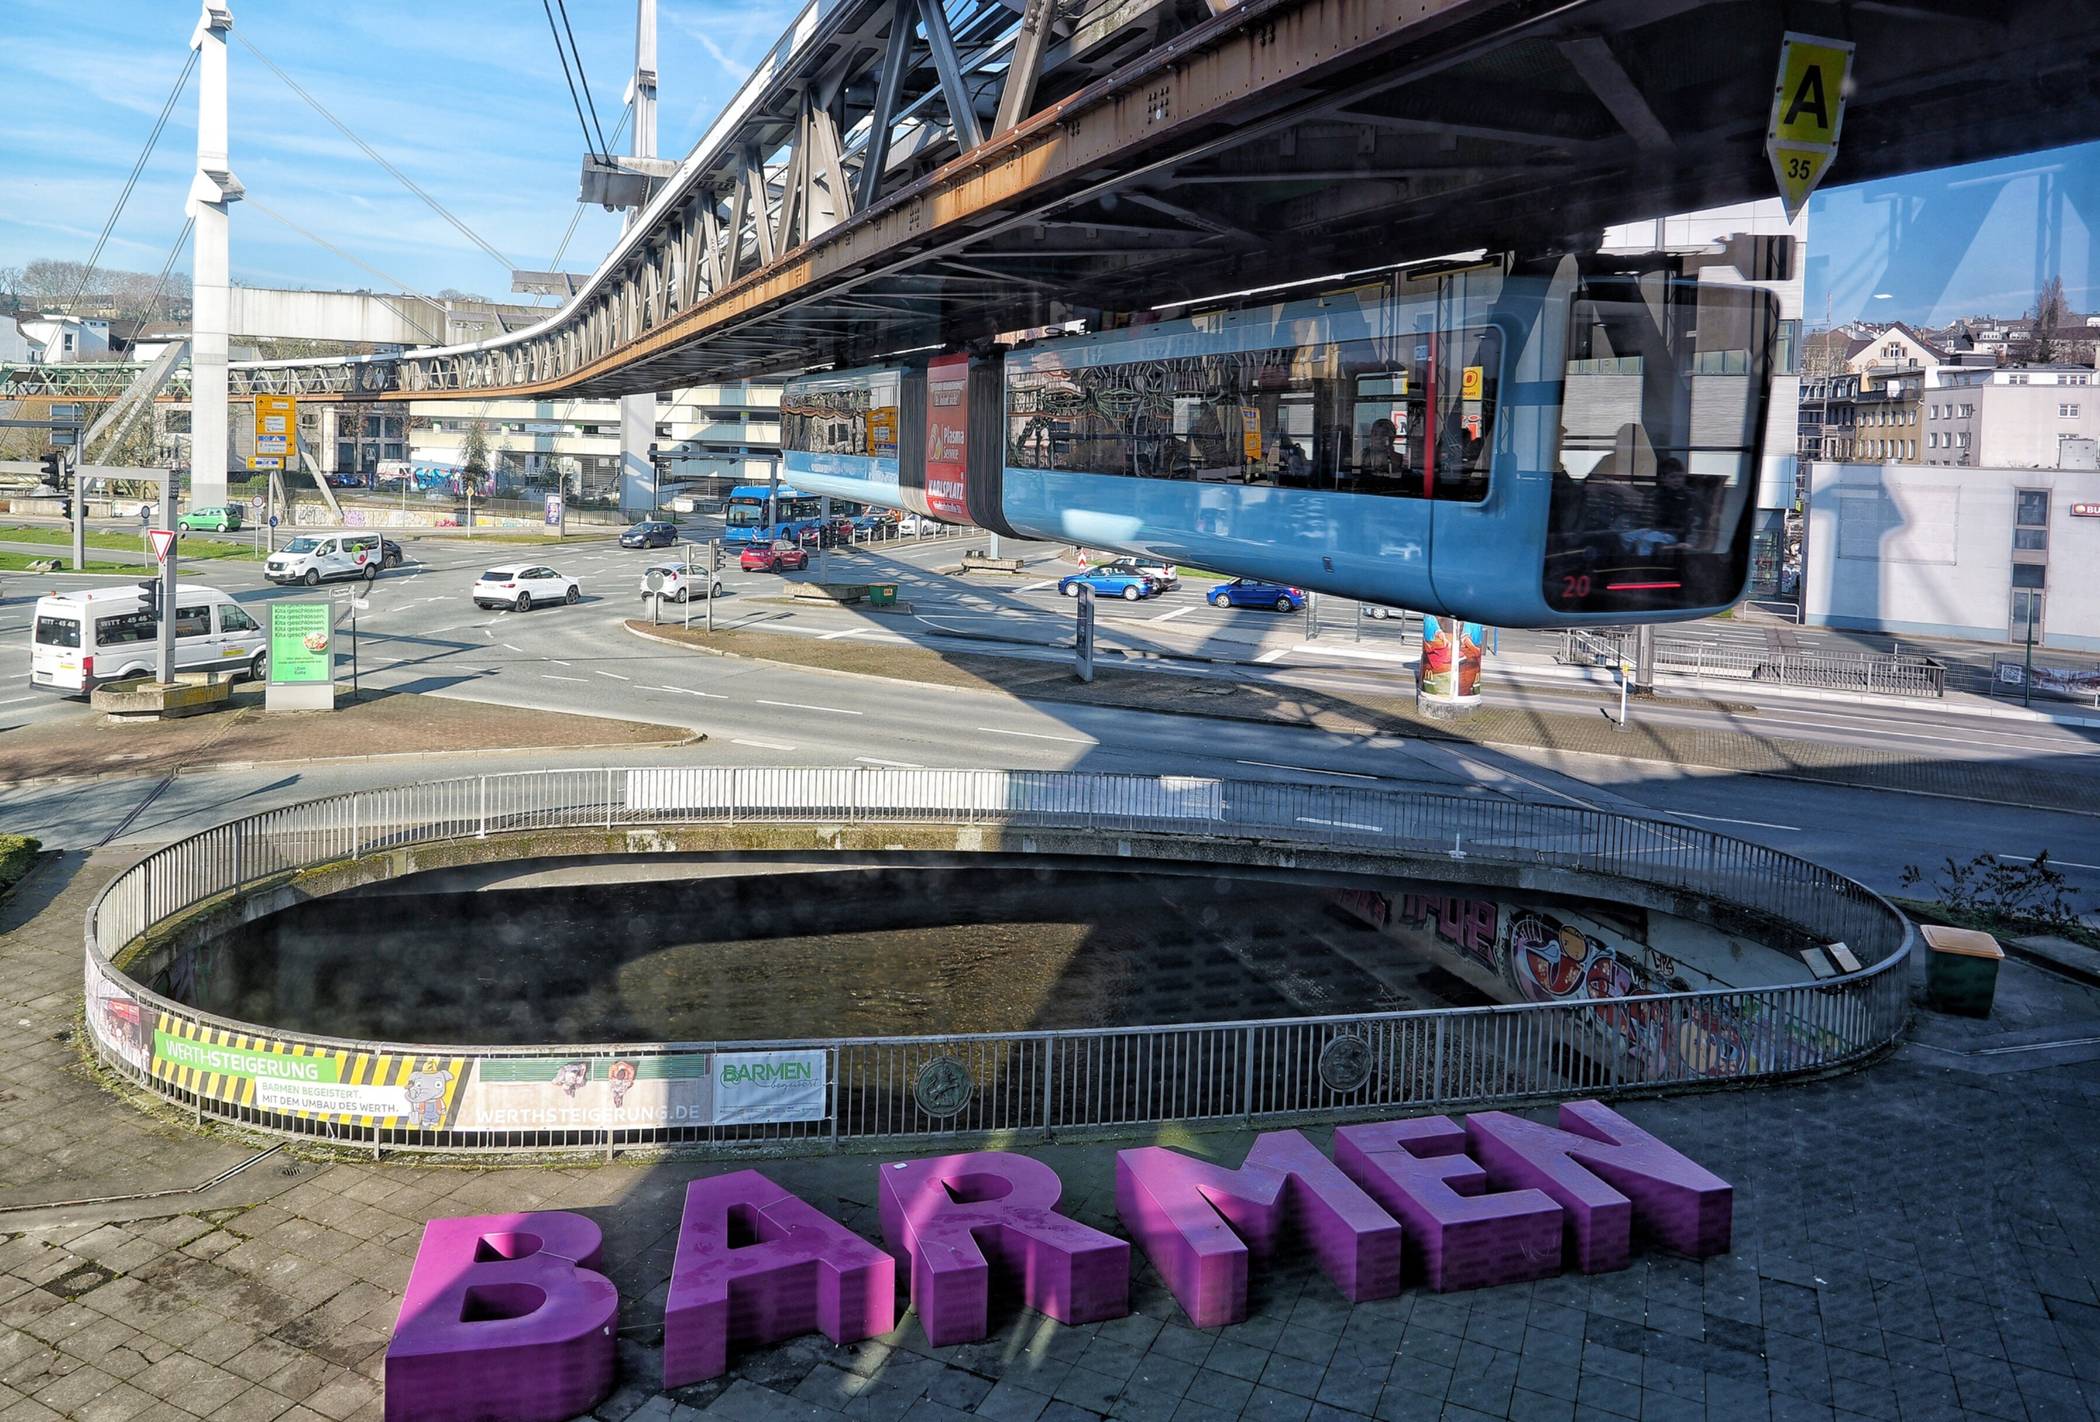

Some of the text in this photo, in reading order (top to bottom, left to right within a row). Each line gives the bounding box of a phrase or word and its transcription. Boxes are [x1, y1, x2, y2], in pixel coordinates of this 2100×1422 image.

[1783, 64, 1828, 129] A
[1787, 158, 1811, 181] 35
[943, 426, 964, 445] Plasma
[928, 480, 964, 500] KARLSPLATZ
[1561, 575, 1591, 598] 20
[165, 1039, 319, 1080] WERTHSTEIGERUNG
[721, 1062, 811, 1083] BARMEN
[261, 1082, 300, 1095] BARMEN
[261, 1094, 400, 1114] MIT DEM UMBAU DES WERTH.
[478, 1104, 700, 1124] WERTHSTEIGERUNG.DE
[384, 1099, 1733, 1422] BARMEN
